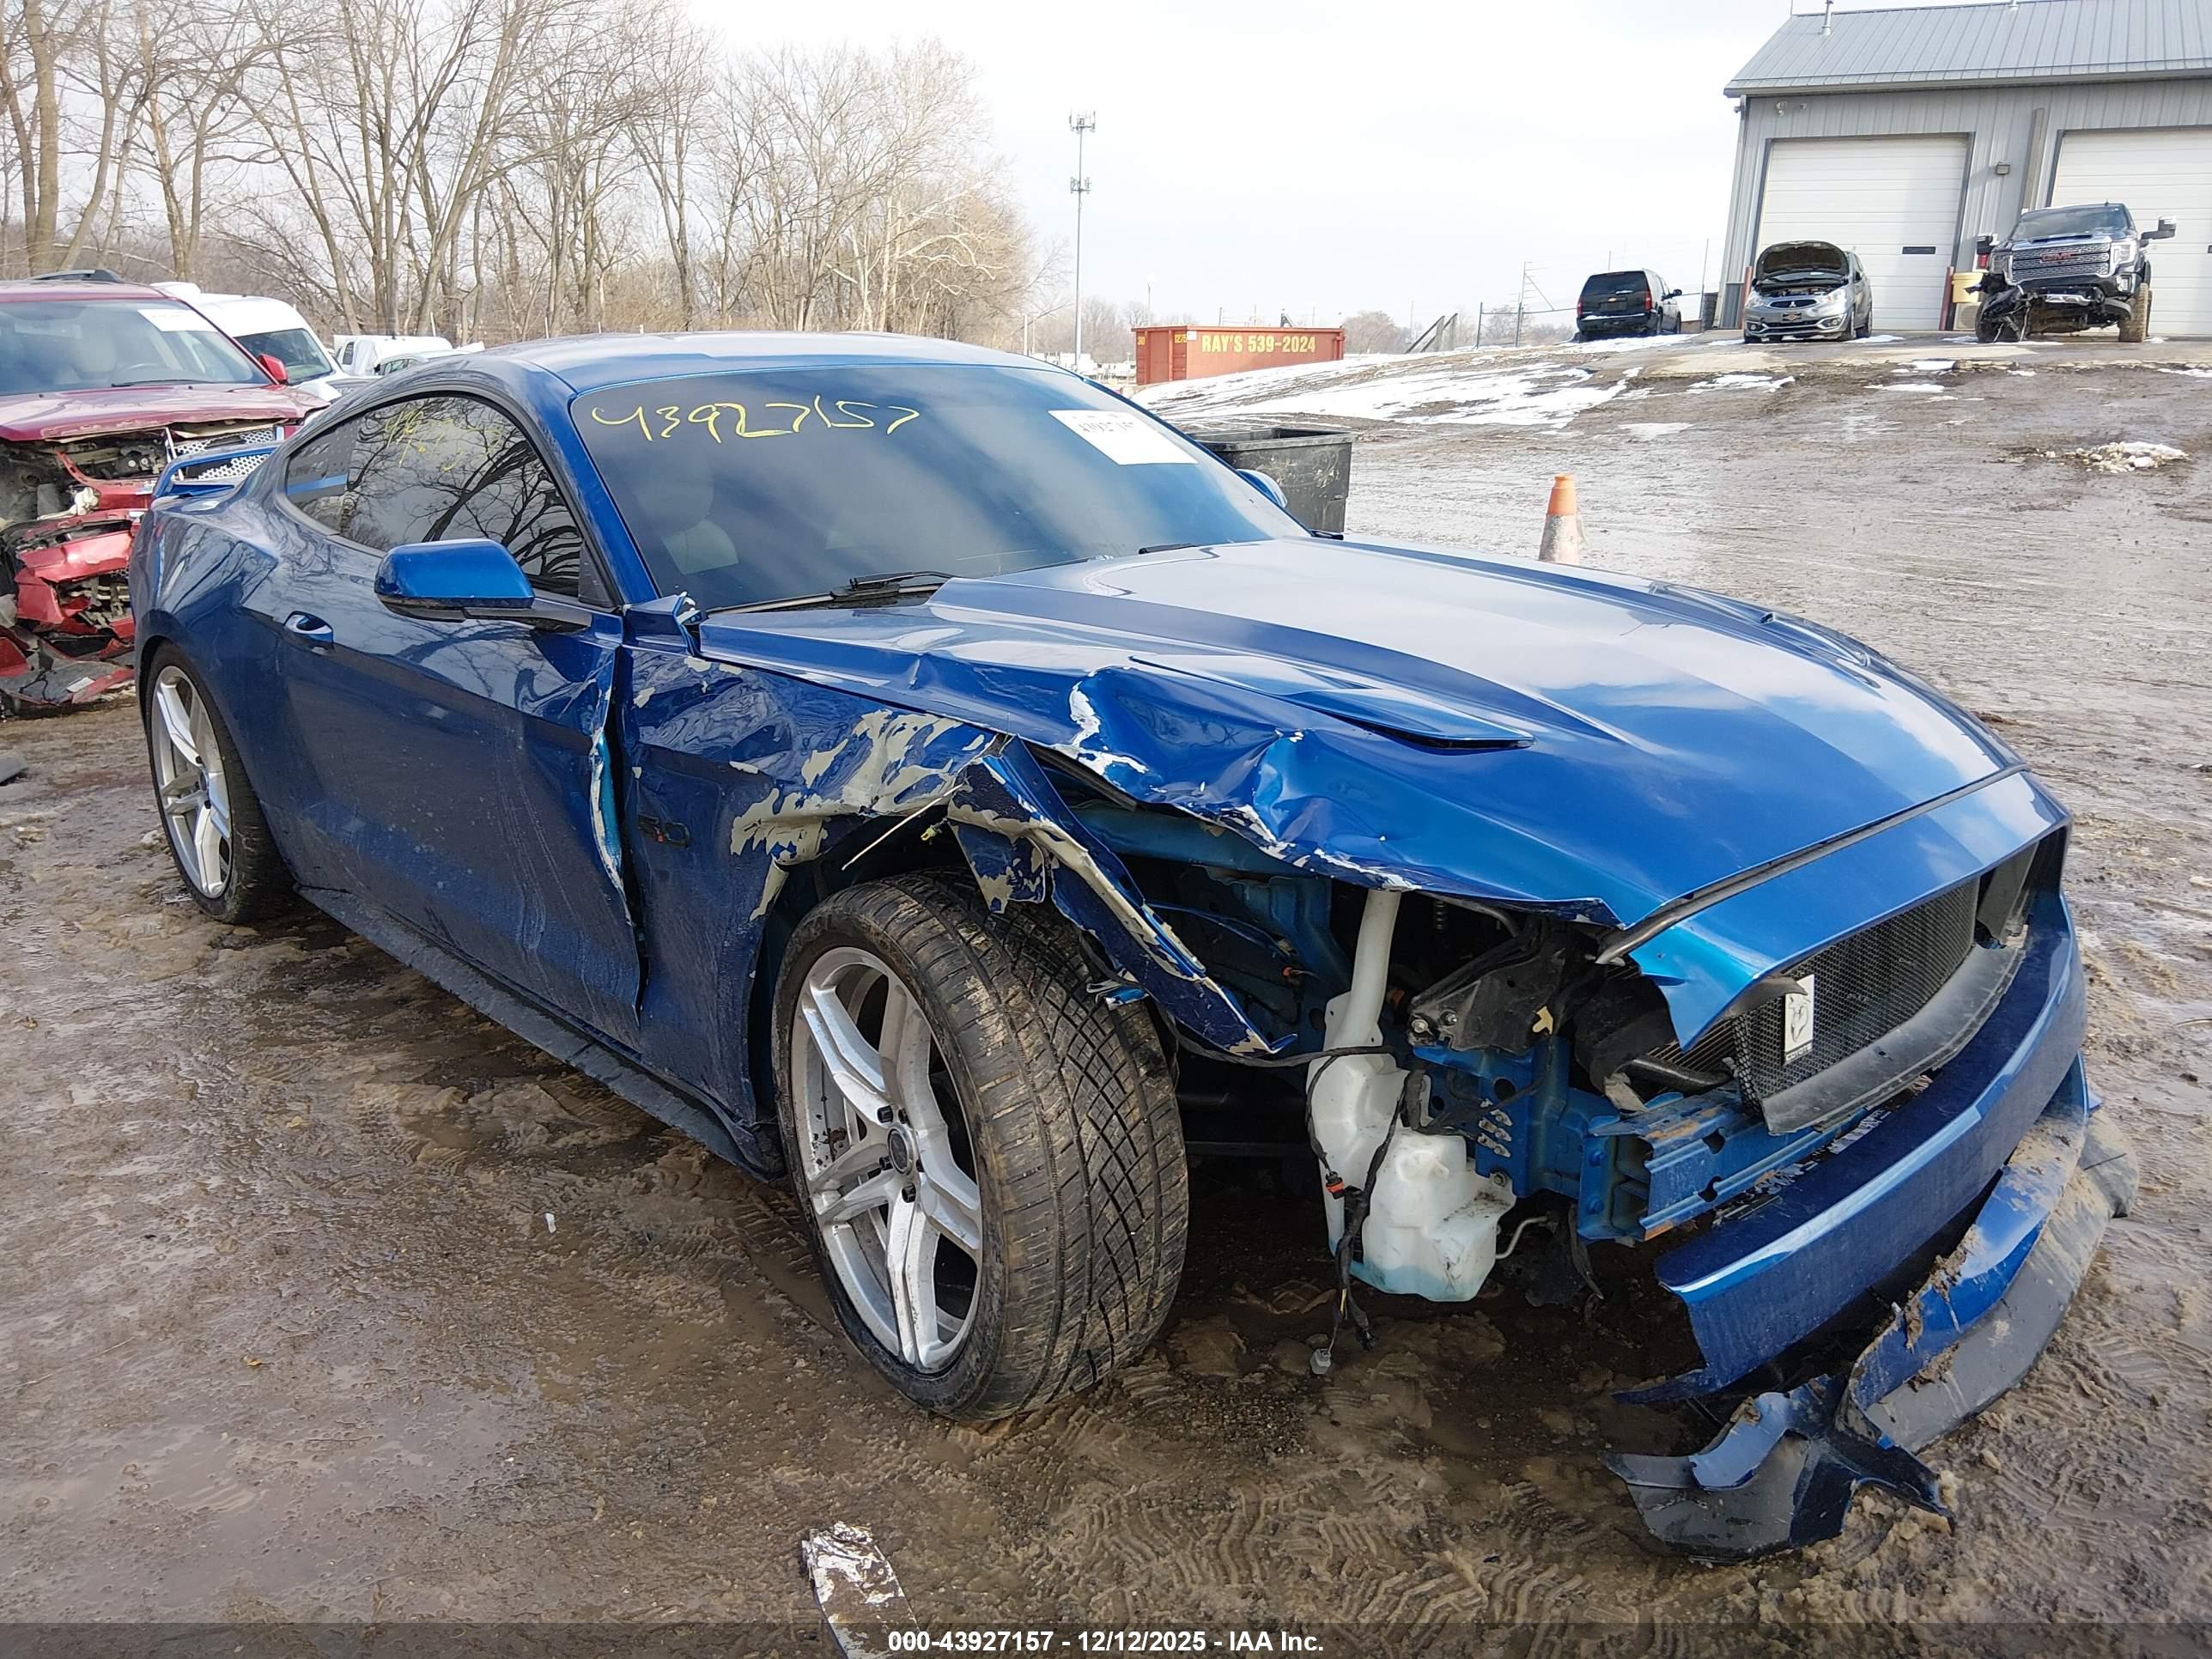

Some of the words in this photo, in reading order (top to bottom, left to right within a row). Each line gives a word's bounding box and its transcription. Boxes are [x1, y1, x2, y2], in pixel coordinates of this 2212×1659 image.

[2042, 252, 2075, 262] GMC
[1201, 336, 1243, 353] RAY'S
[1248, 335, 1316, 353] 539-2024
[591, 395, 921, 444] 43927157
